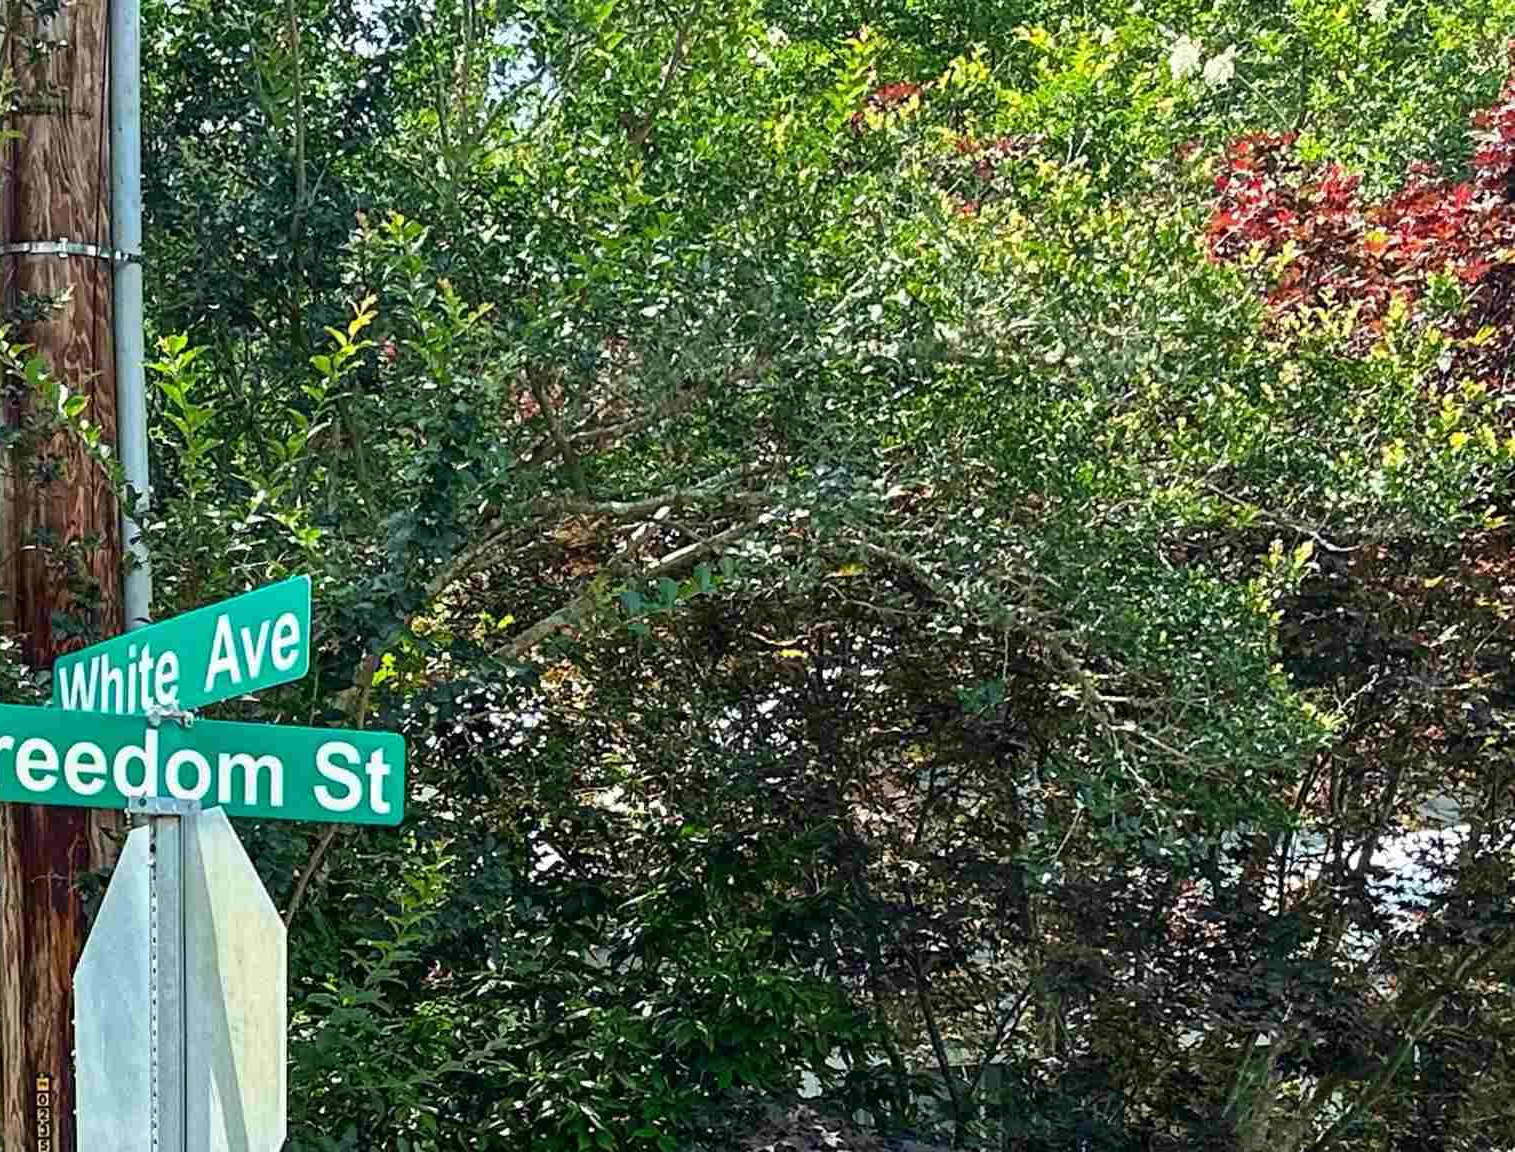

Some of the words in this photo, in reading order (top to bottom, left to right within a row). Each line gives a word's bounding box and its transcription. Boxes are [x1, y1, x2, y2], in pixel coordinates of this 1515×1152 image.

[58, 643, 180, 714] White
[203, 609, 300, 692] Ave
[313, 741, 392, 815] St
